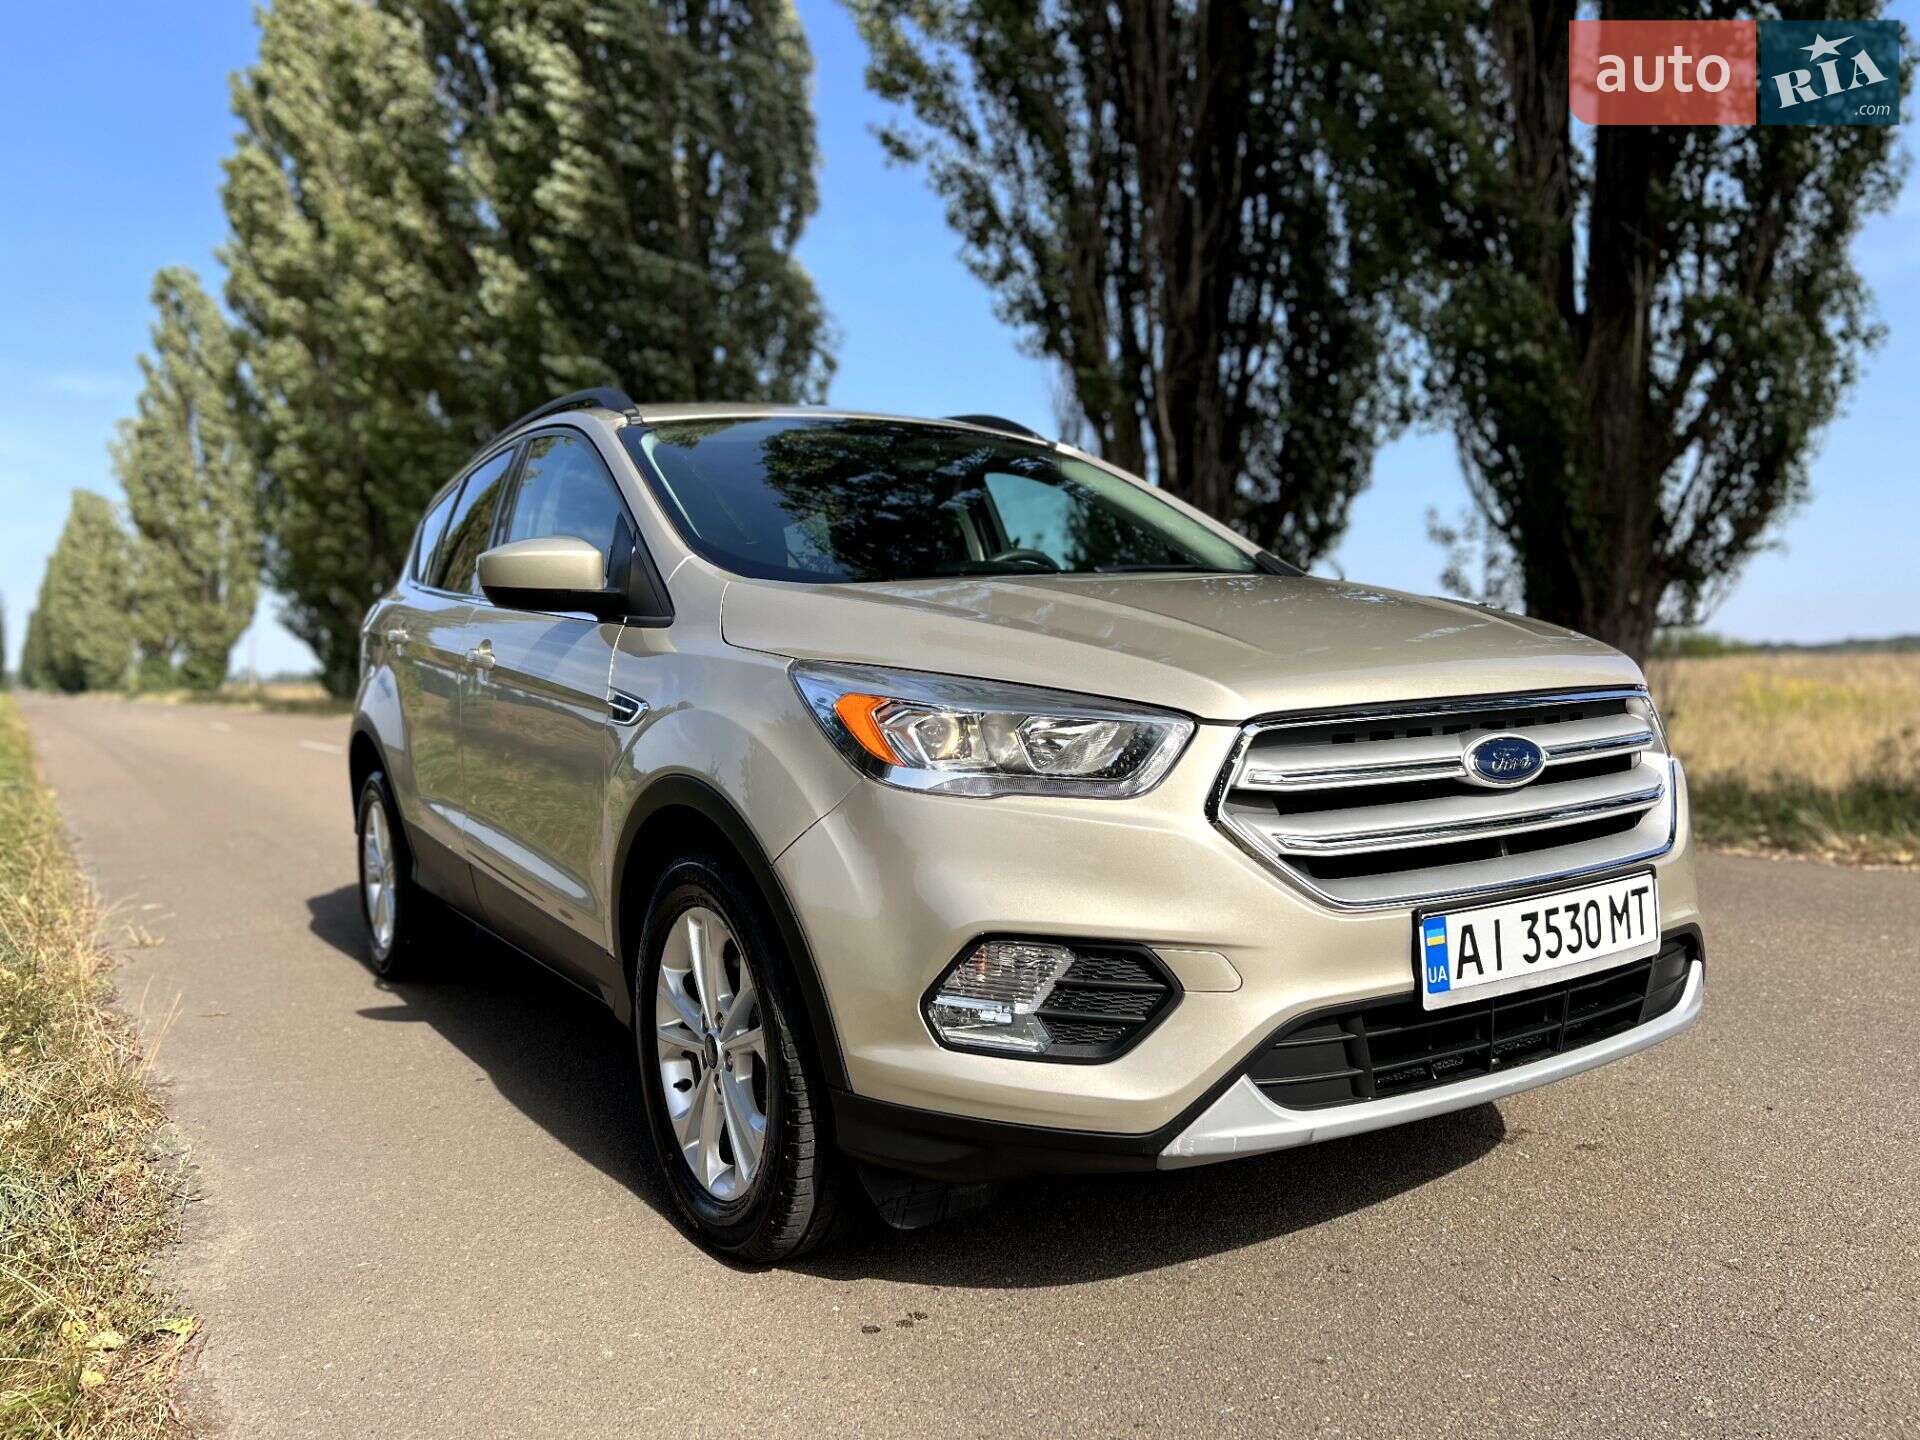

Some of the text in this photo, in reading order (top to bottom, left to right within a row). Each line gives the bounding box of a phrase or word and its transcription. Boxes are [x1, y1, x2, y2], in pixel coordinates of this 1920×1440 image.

[1491, 747, 1532, 774] Ford
[1456, 885, 1649, 980] AI 3530 MT
[1428, 966, 1448, 984] UA
